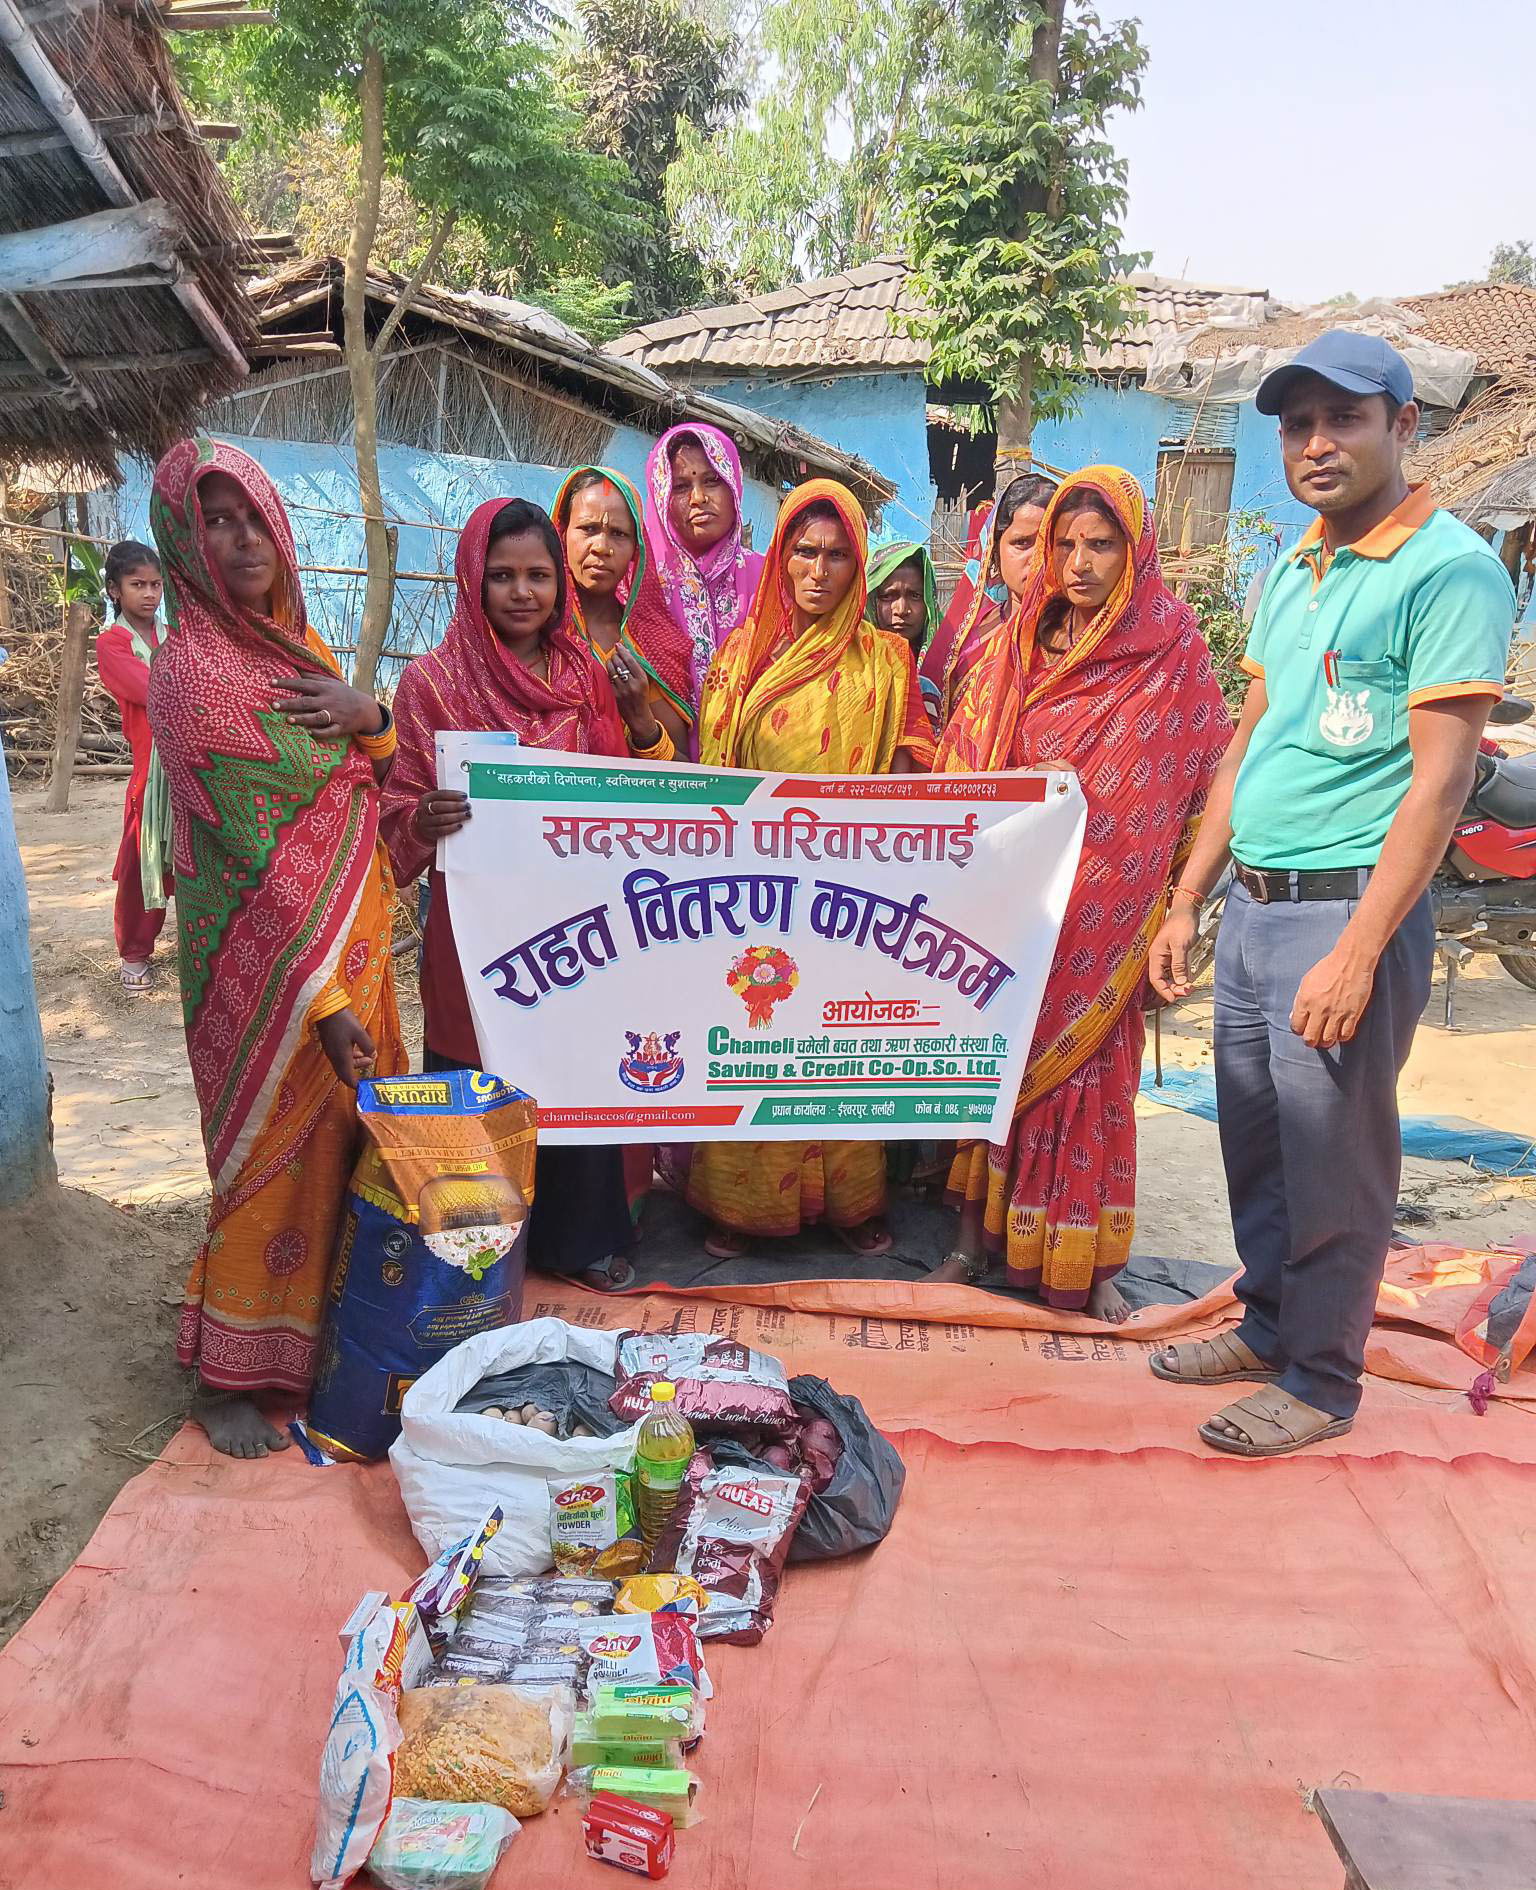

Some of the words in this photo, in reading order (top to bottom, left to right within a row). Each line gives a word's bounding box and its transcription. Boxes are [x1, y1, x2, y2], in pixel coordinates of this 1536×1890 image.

[658, 778, 665, 789] र
[542, 806, 738, 859] सदस्यको
[752, 806, 979, 869] परिवारलाई
[480, 903, 618, 1007] राहत
[622, 868, 799, 950] वितरण
[810, 880, 1016, 1011] कार्यक्रम
[708, 1025, 794, 1056] Chameli
[797, 1035, 829, 1054] चमेली
[833, 1040, 856, 1054] बचत
[860, 1040, 882, 1053] तथा
[885, 1039, 909, 1053] ऋण
[913, 1035, 955, 1053] सहकारी
[959, 1034, 988, 1053] संस्था
[992, 1032, 1009, 1052] लि.
[708, 1061, 778, 1078] Saving
[783, 1063, 798, 1077] &
[802, 1059, 864, 1077] Credit
[868, 1059, 962, 1077] Co-Op.So.
[967, 1059, 1001, 1076] Ltd.
[379, 1089, 448, 1105] RIPURAJ
[543, 1109, 696, 1124] chamelisaccos@gmail.com
[772, 1104, 791, 1117] प्रधान
[794, 1104, 826, 1116] कार्यालय
[915, 1102, 932, 1115] फोन
[623, 1396, 654, 1411] HULA
[718, 1485, 771, 1514] HULAS
[557, 1520, 591, 1530] POWDER
